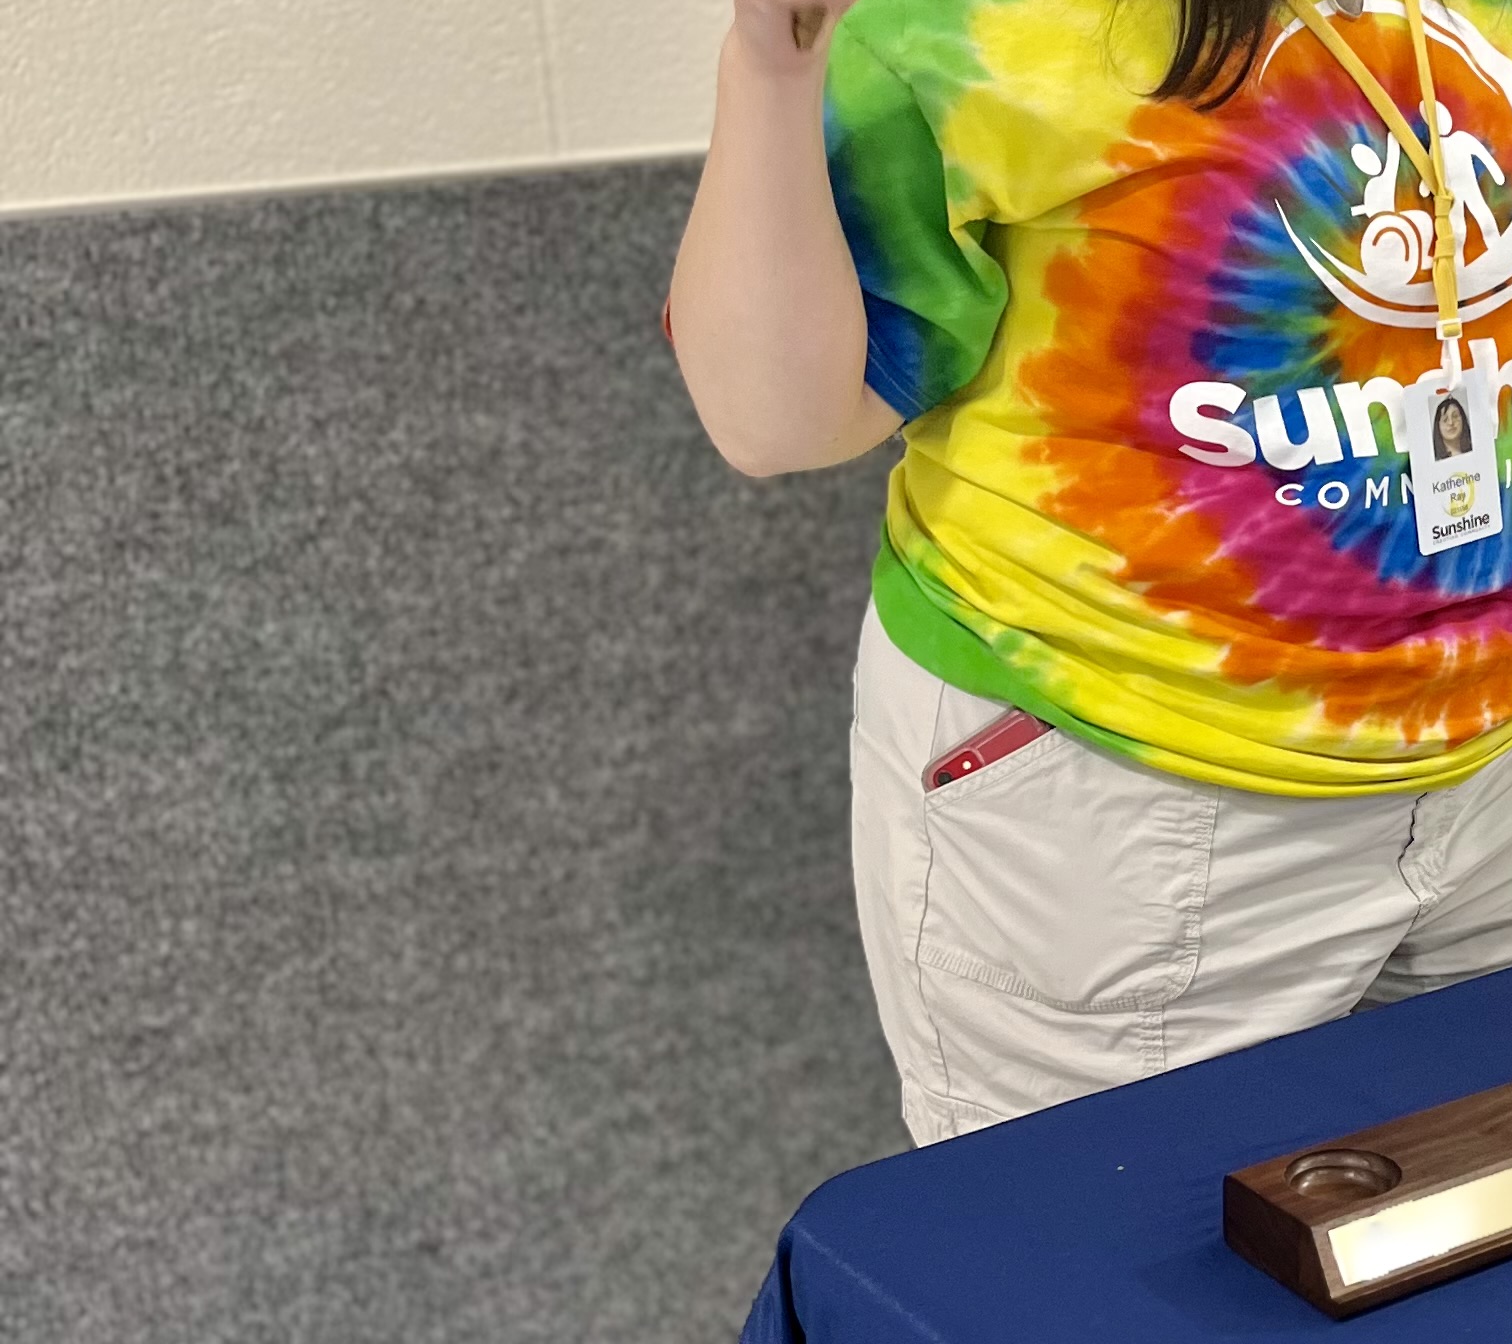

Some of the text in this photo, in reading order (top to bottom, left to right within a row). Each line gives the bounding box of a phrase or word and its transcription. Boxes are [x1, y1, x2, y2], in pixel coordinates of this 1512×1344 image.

[1431, 471, 1482, 495] Katherine
[1449, 490, 1467, 504] Ray
[1431, 512, 1491, 541] Sunshine
